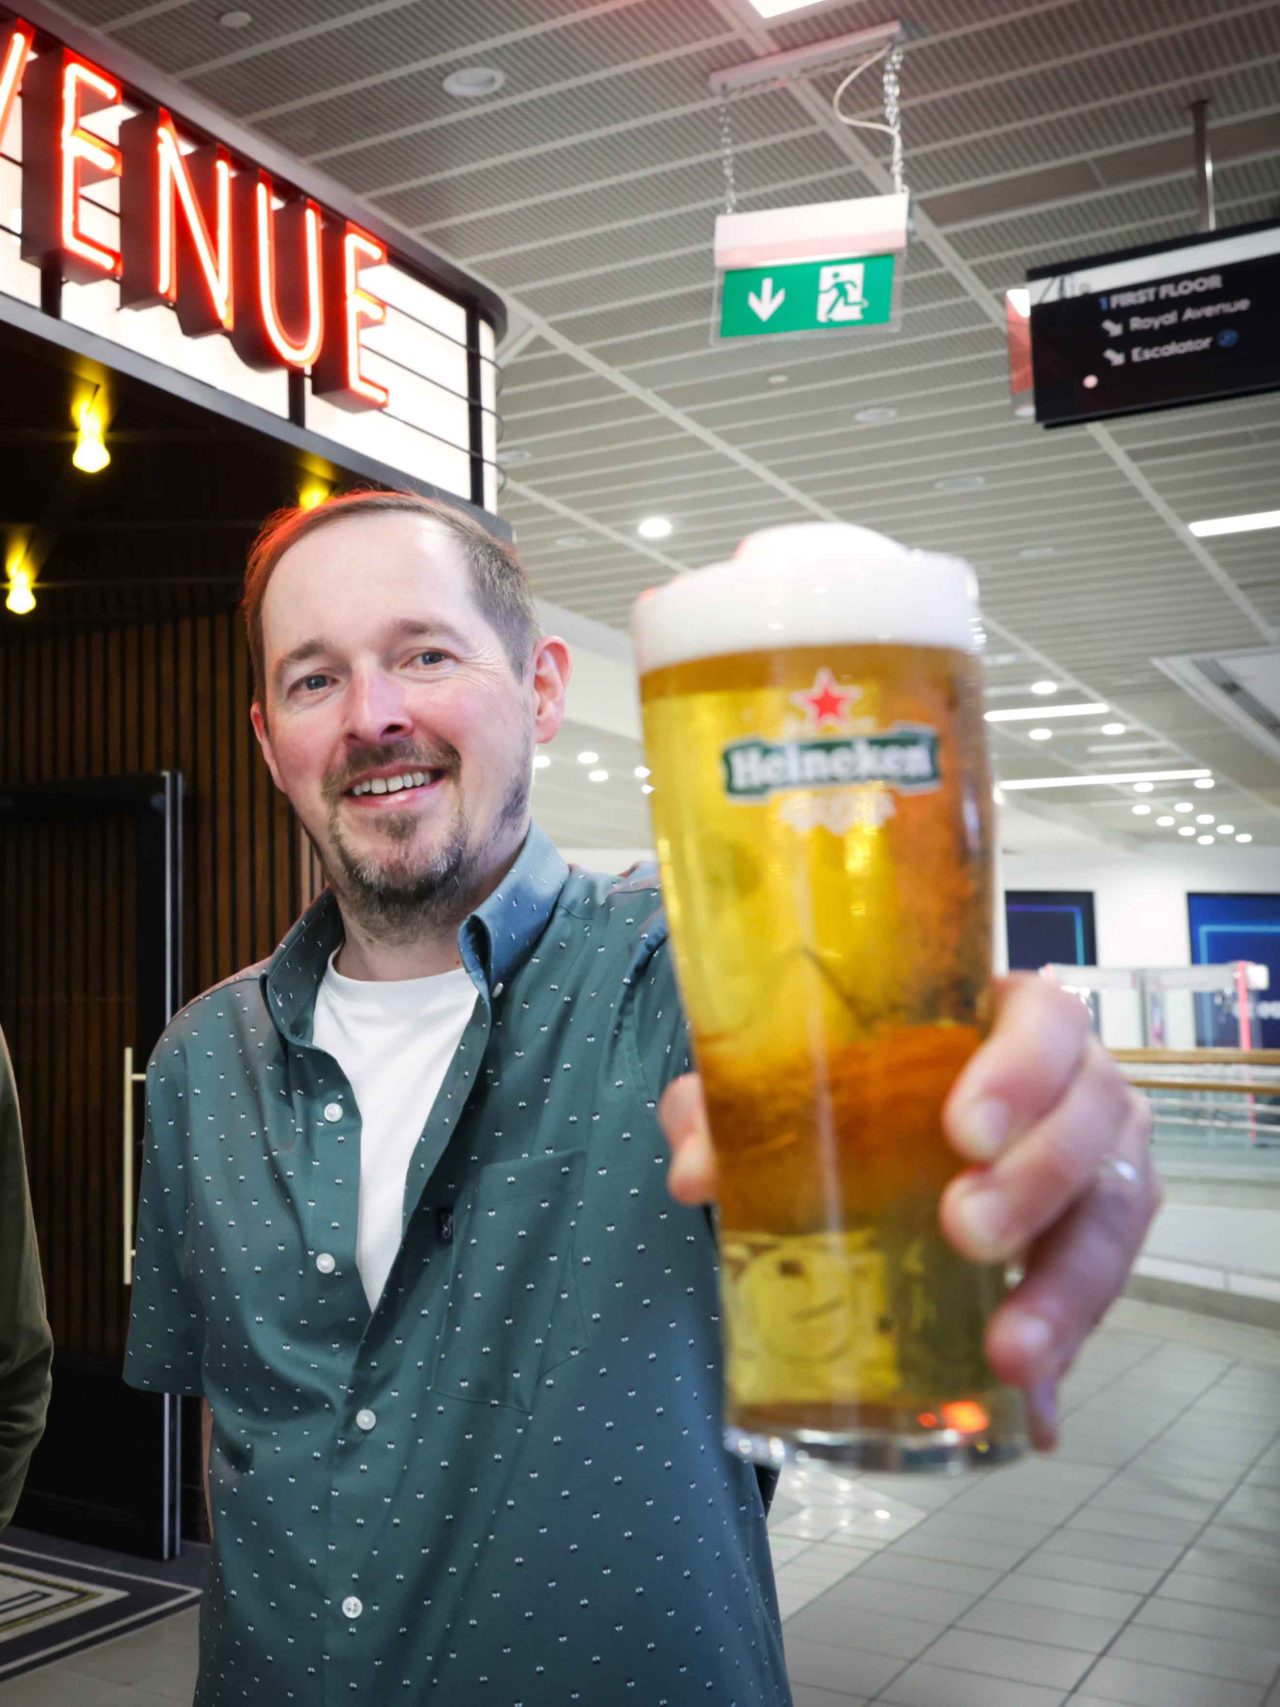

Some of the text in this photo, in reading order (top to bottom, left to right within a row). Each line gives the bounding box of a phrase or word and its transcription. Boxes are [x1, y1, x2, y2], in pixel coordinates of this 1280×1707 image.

[1109, 286, 1156, 310] FIRST
[1158, 274, 1223, 300] FLOOR
[1129, 298, 1251, 331] Royal Avenue
[1131, 336, 1213, 363] Escalator
[729, 739, 933, 790] Heineken
